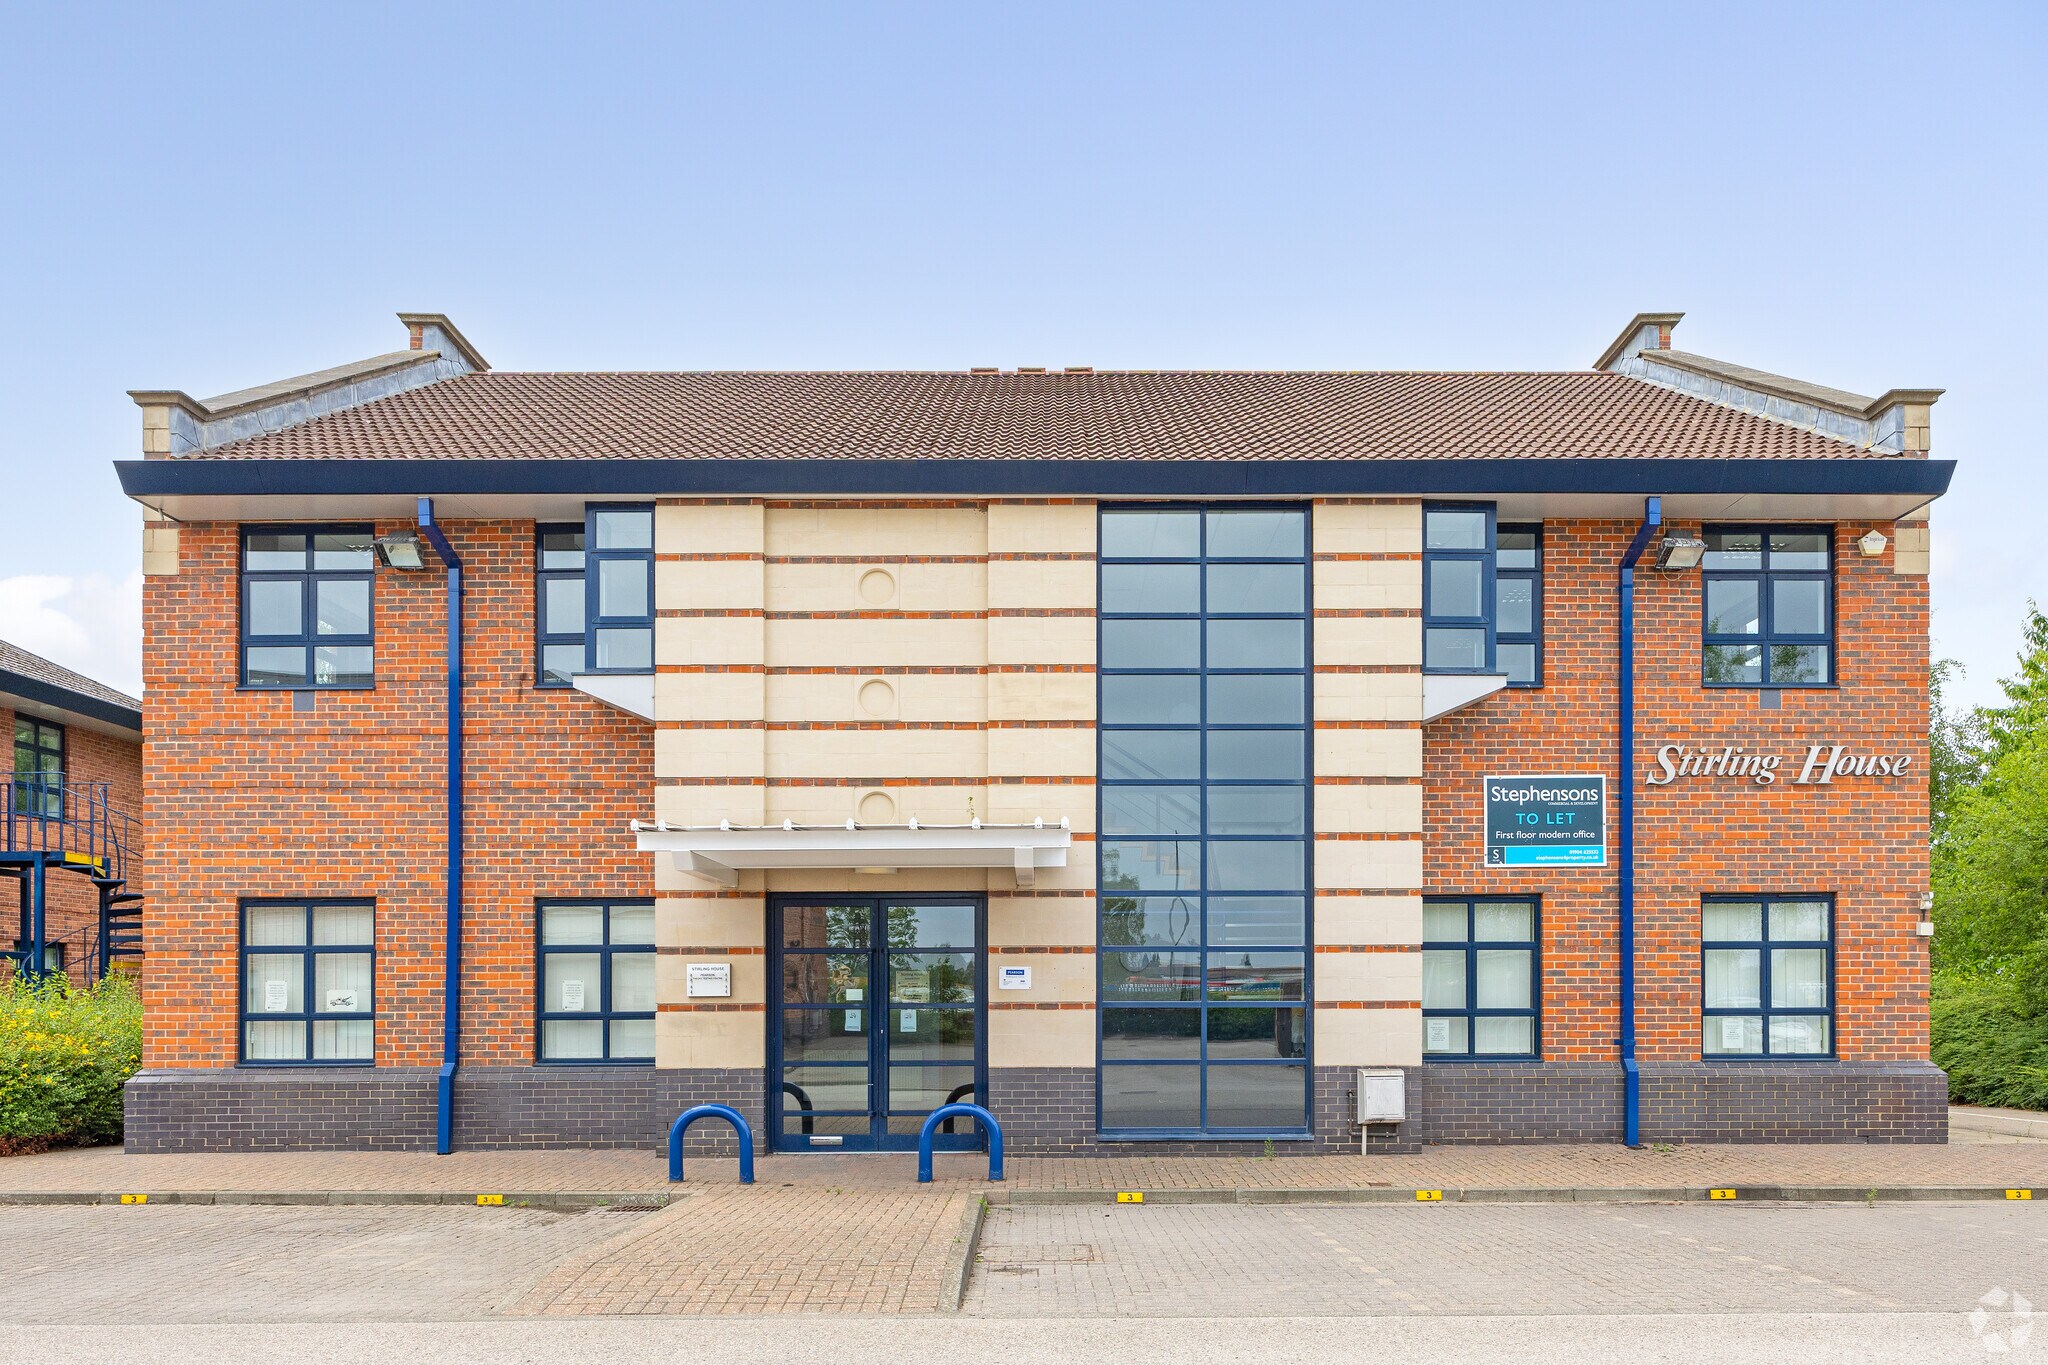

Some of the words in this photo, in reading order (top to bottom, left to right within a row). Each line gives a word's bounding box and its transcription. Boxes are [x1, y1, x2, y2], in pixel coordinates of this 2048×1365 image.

[1645, 744, 1783, 785] Stirling
[1792, 745, 1912, 785] House
[1491, 785, 1599, 806] Stephensons
[1515, 812, 1539, 825] TO
[1546, 812, 1576, 825] LET
[1495, 830, 1514, 839] First
[1516, 830, 1537, 839] floor
[1538, 830, 1571, 839] modern
[1572, 830, 1596, 839] office
